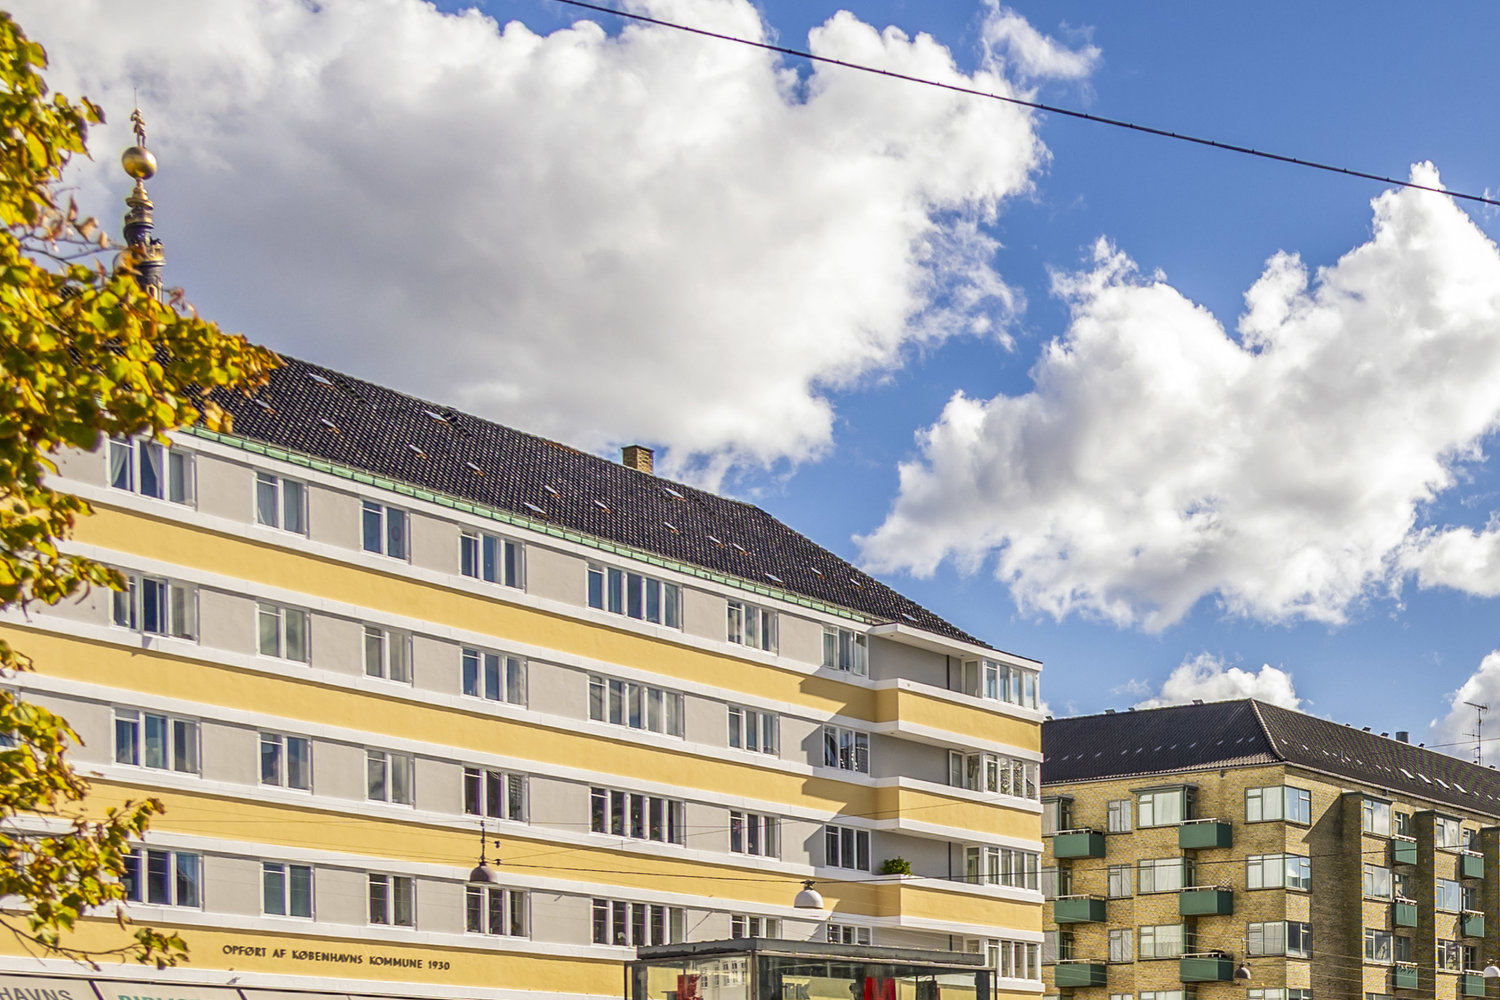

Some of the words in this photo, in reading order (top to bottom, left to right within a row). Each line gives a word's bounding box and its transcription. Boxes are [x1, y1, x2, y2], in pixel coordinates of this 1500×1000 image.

[222, 944, 266, 957] OPFØRT
[272, 949, 286, 959] AF
[292, 950, 363, 965] KØBENHAVNS
[369, 956, 423, 969] KOMMUNE
[428, 960, 451, 971] 1930
